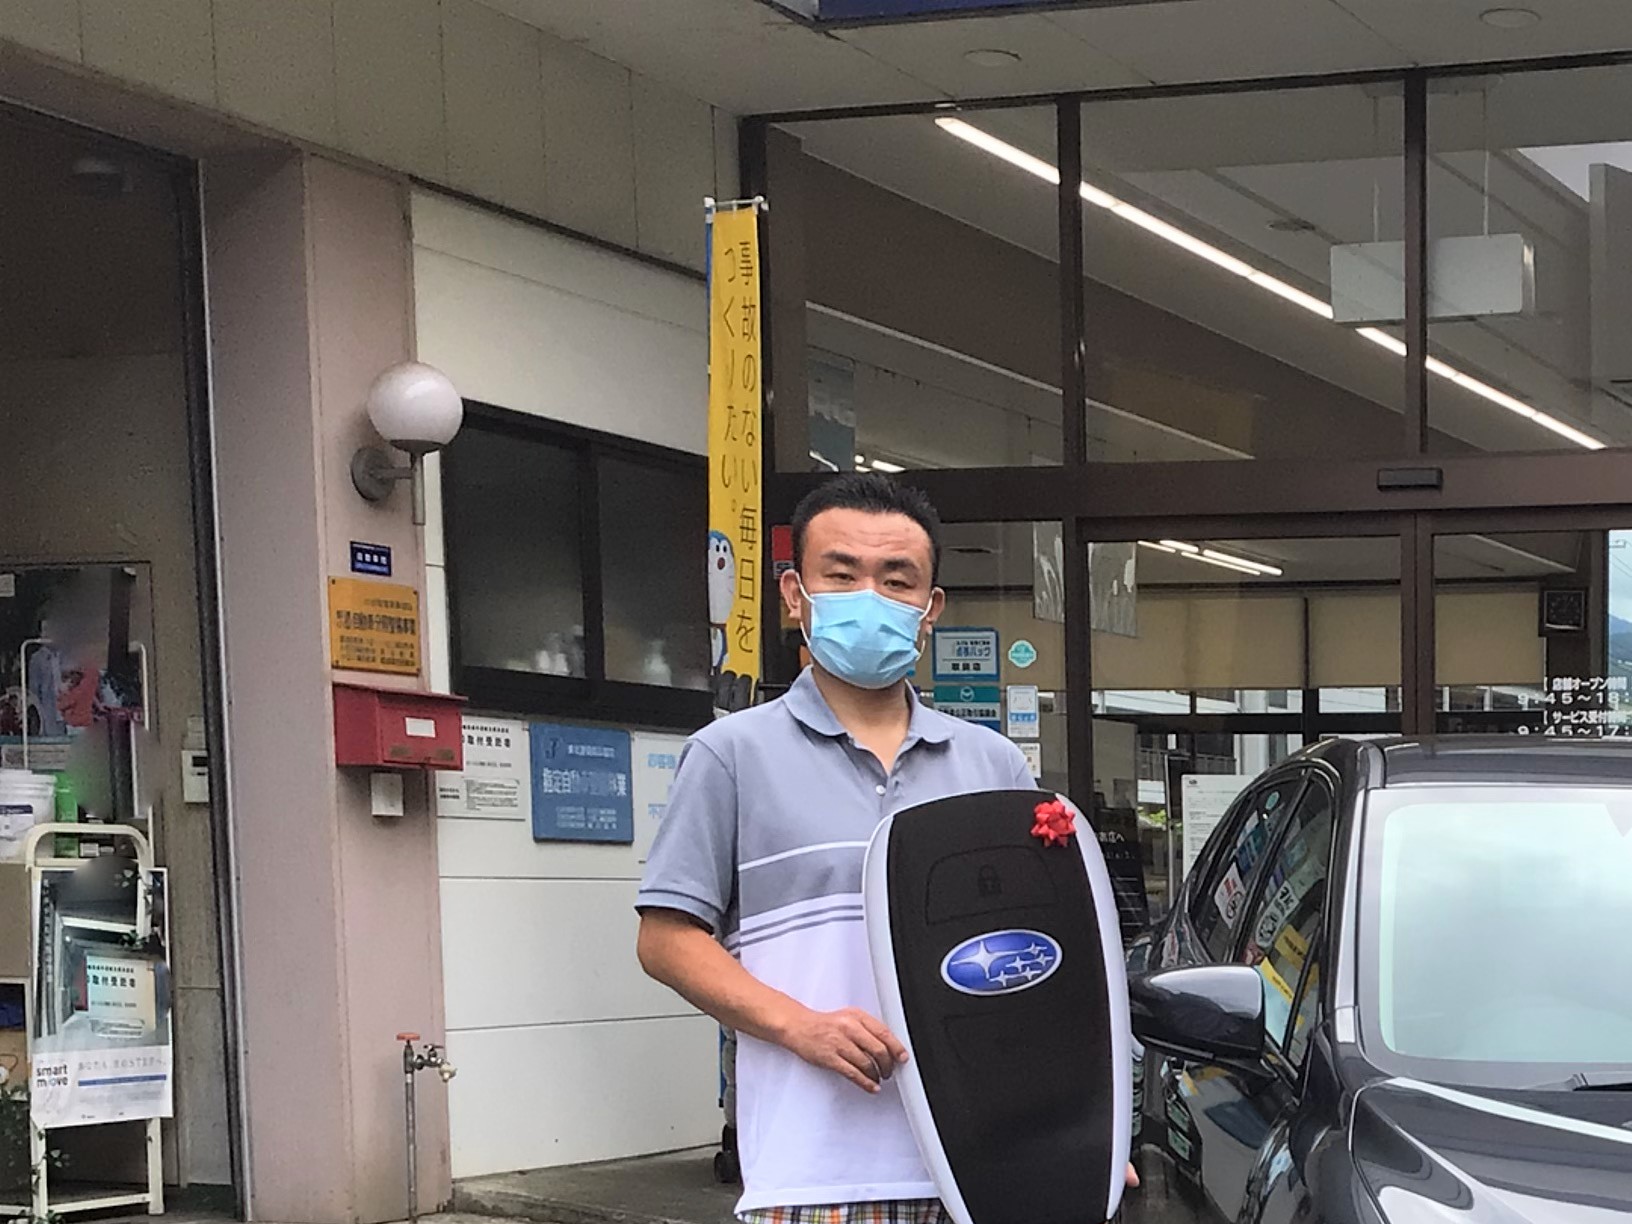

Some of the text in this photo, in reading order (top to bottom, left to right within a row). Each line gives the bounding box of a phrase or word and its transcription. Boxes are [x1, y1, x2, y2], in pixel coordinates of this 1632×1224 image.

[721, 247, 738, 513] つくりたい。
[737, 240, 757, 654] 事故のない毎日を
[36, 1064, 68, 1076] smart
